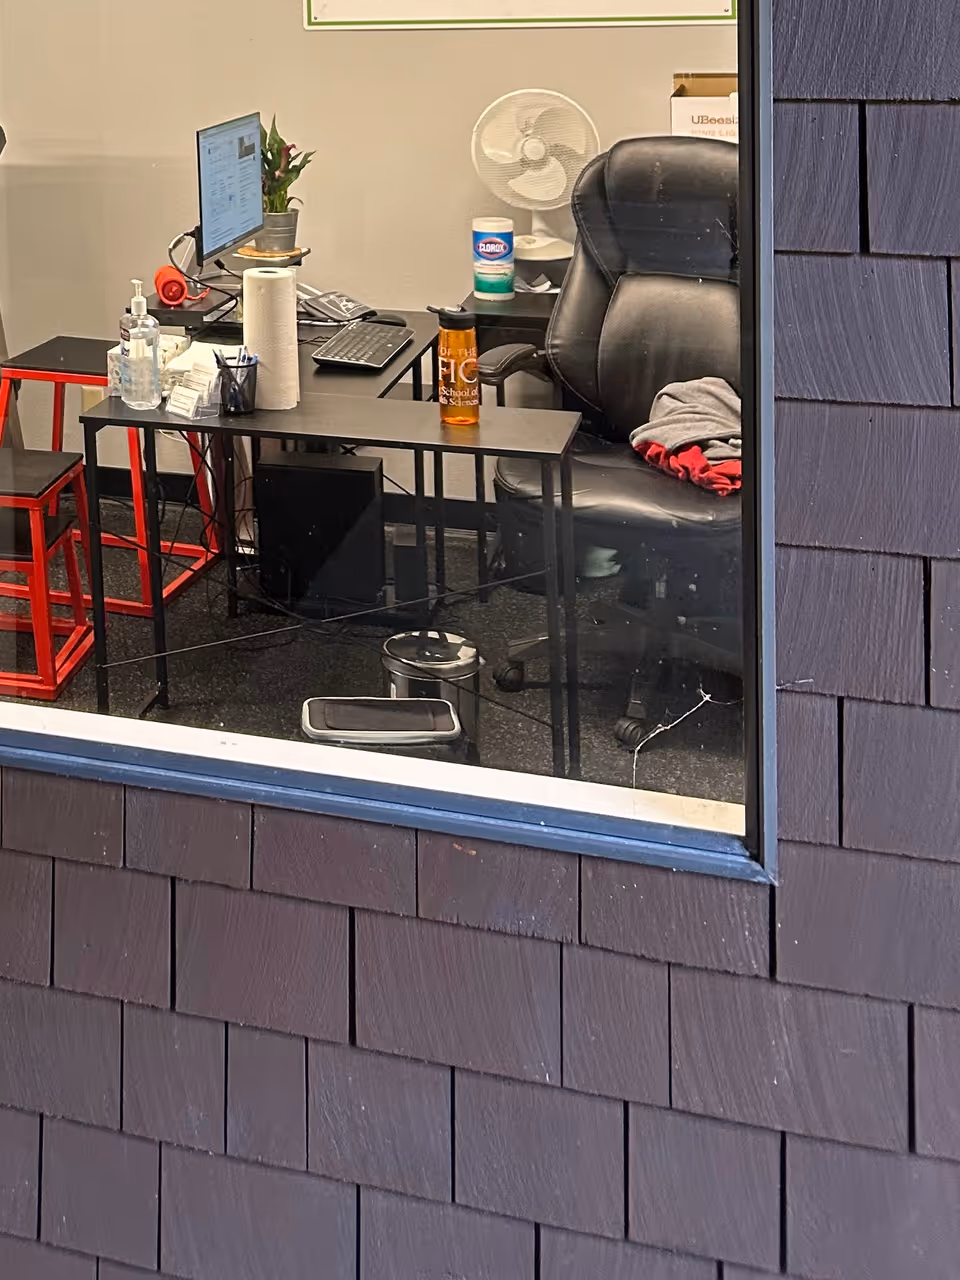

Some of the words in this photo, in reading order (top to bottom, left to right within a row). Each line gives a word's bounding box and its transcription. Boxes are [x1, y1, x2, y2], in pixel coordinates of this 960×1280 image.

[479, 242, 505, 253] CLOROX
[458, 348, 478, 357] THE
[441, 385, 470, 397] School
